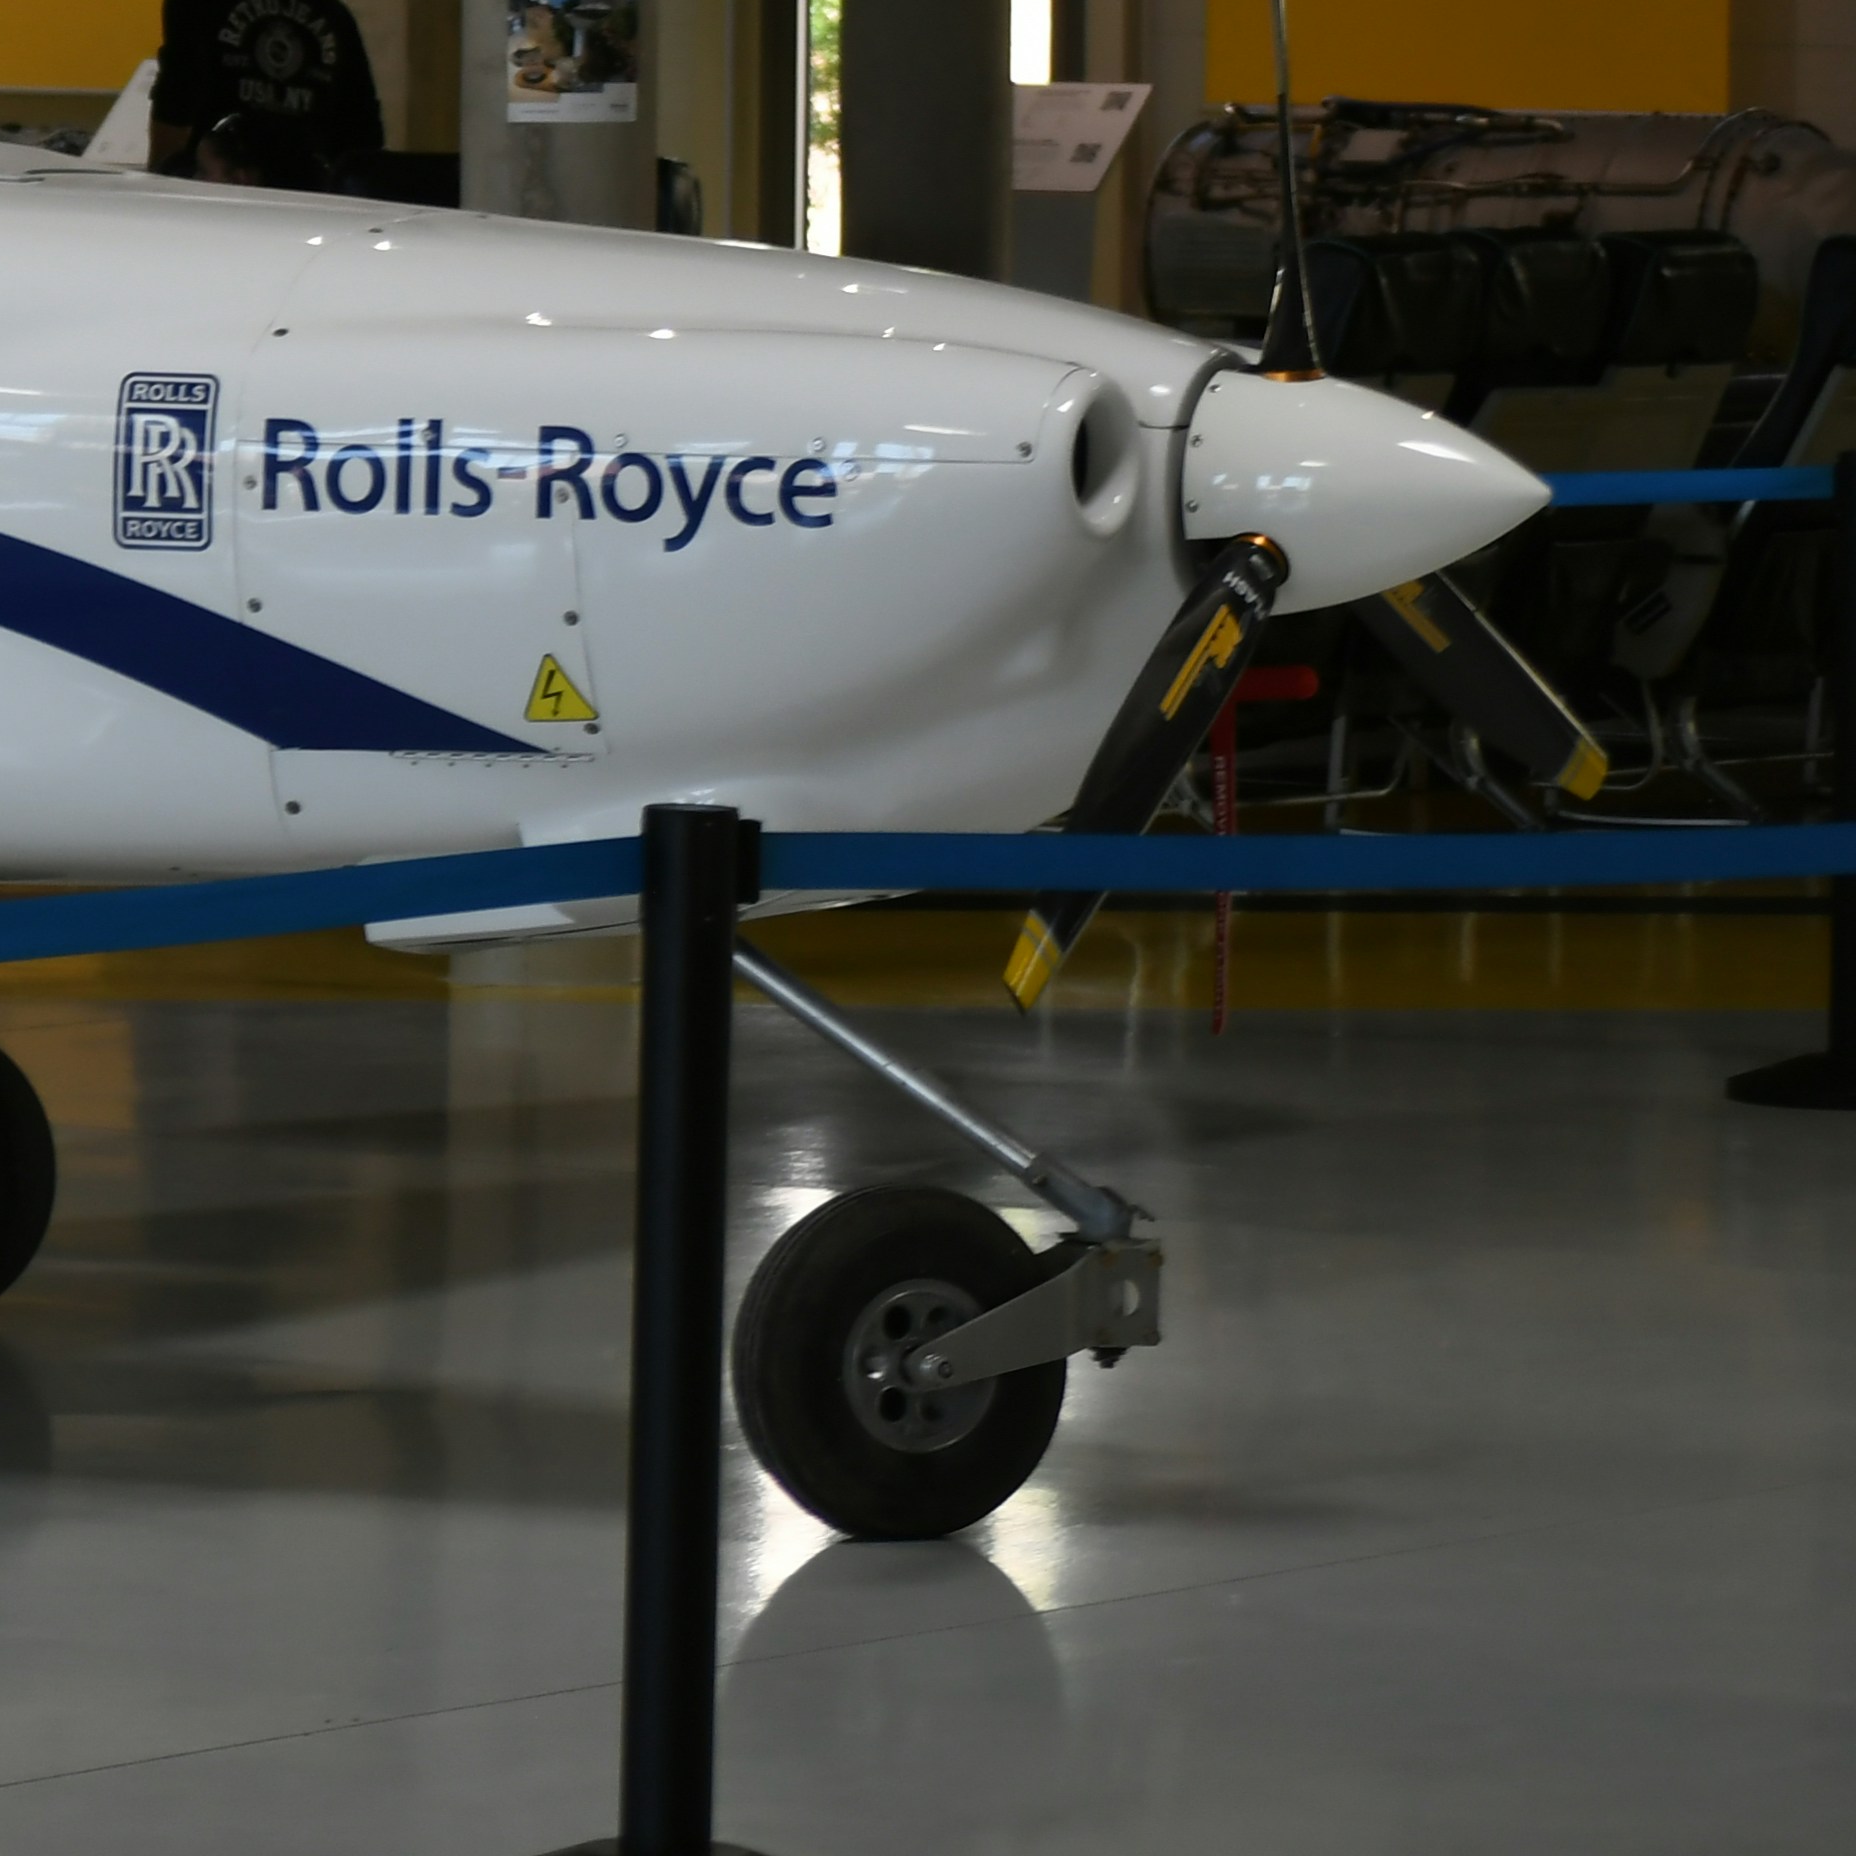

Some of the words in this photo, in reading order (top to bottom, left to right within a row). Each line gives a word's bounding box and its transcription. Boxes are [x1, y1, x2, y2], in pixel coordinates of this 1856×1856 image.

[131, 382, 208, 403] ROLLS
[261, 416, 838, 553] Rolls-Royce
[125, 519, 200, 540] ROYCE
[1214, 755, 1228, 836] REMOV
